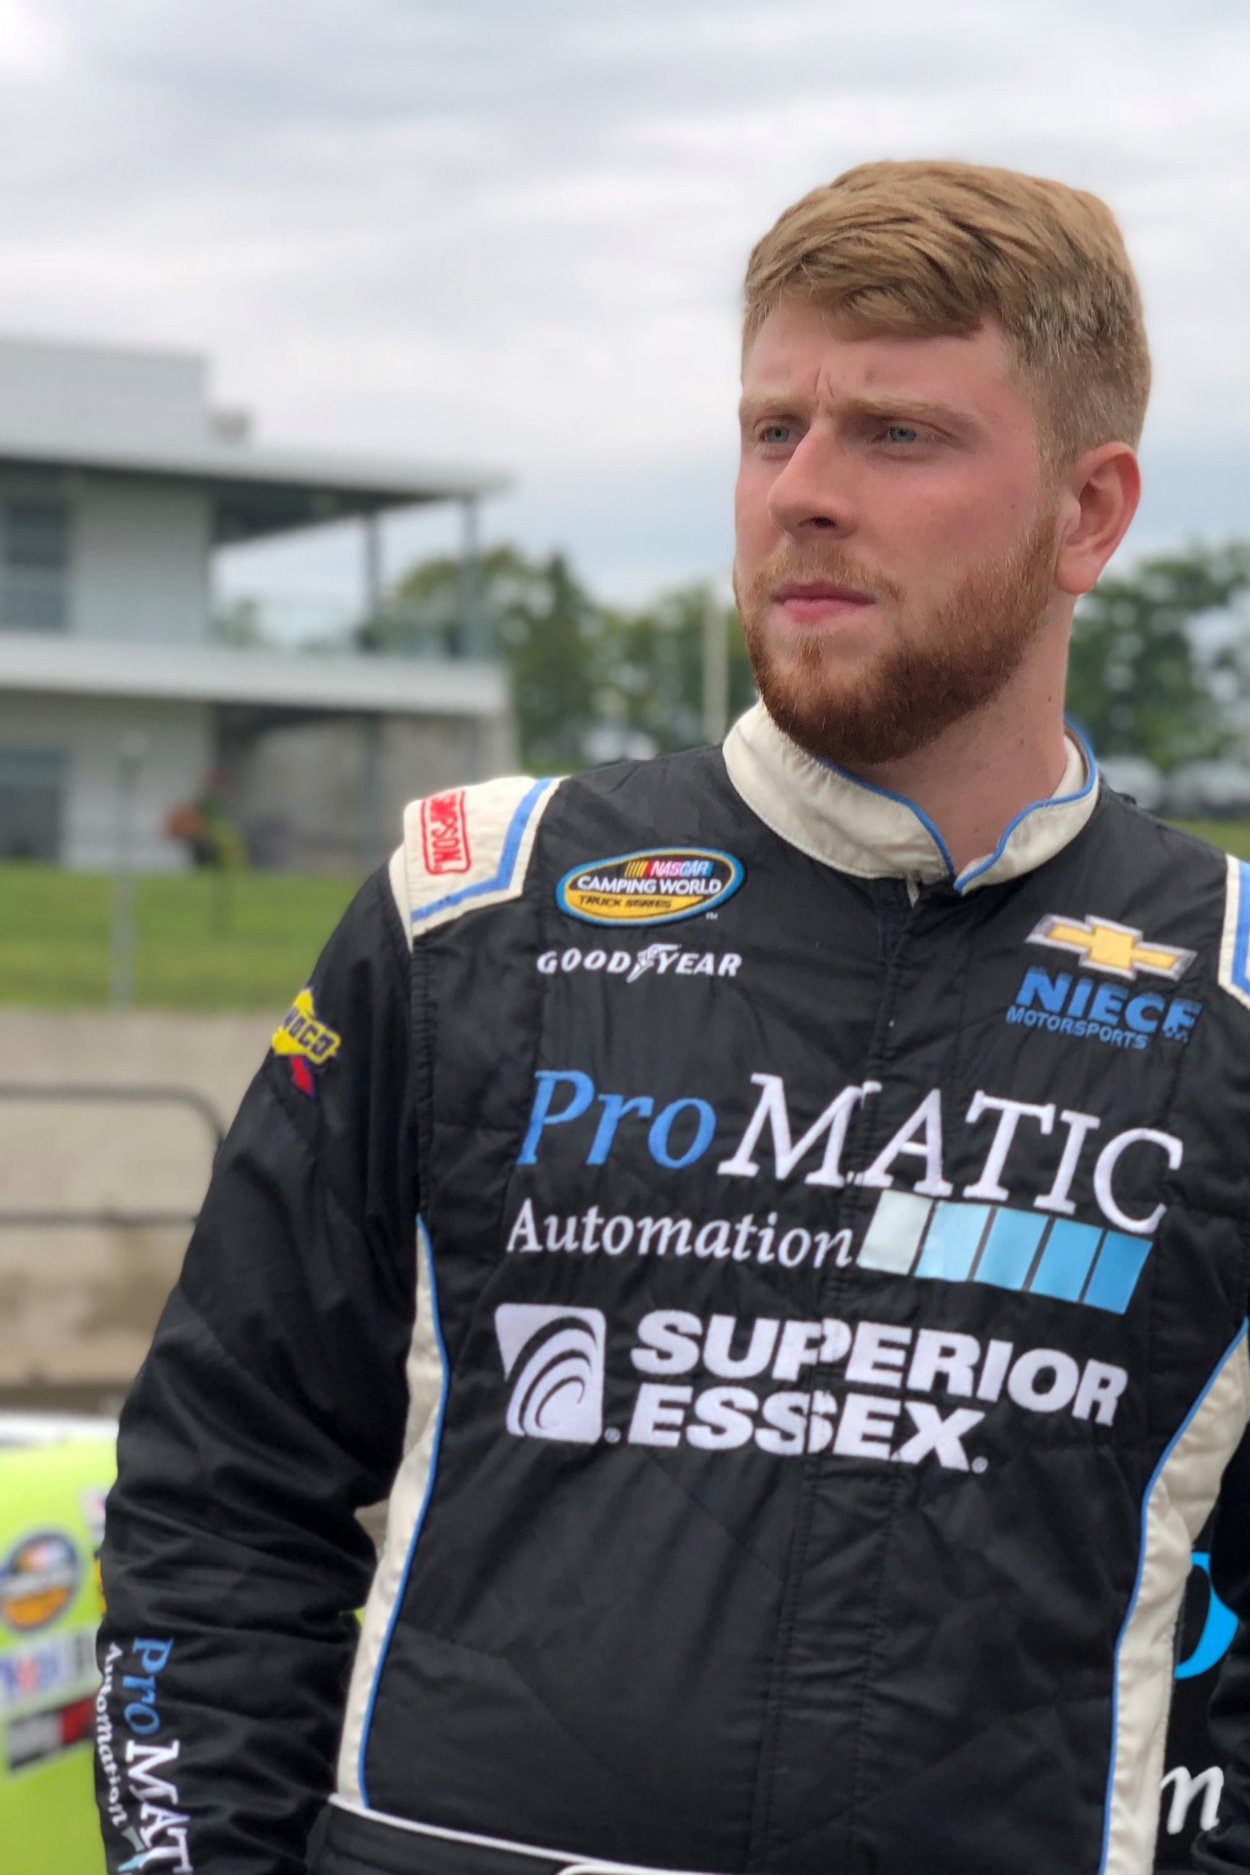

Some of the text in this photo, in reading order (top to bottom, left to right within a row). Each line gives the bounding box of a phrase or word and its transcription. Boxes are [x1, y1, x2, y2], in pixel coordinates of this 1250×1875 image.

[430, 792, 461, 864] MPSON
[577, 875, 722, 895] CAMPING WORLD
[650, 860, 708, 877] NASCAR
[579, 895, 621, 908] TRUCK
[1005, 1006, 1149, 1050] MOTORSPORTS
[506, 1199, 852, 1269] Automation
[630, 1308, 1129, 1427] SUPERIOR
[627, 1381, 987, 1473] ESSEX
